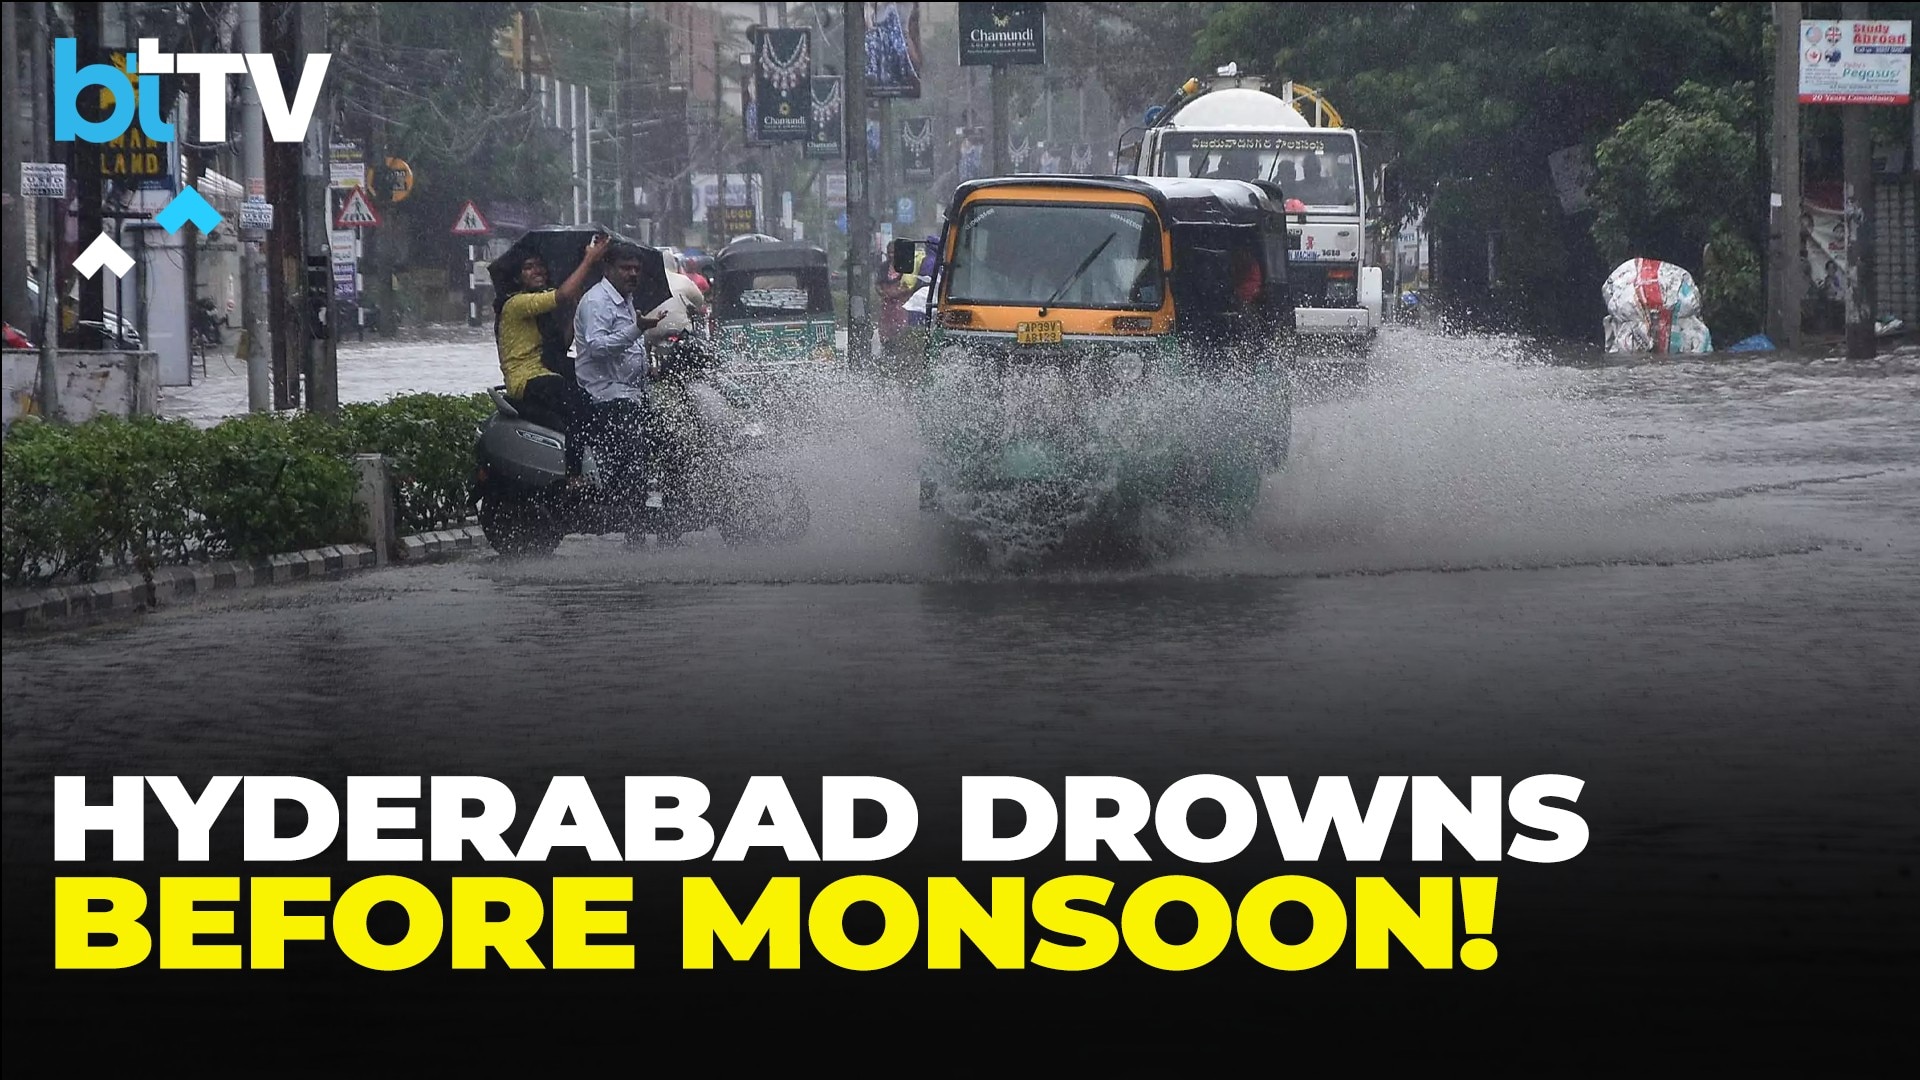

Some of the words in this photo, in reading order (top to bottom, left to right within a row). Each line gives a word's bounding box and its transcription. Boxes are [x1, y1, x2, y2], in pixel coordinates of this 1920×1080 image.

[1853, 23, 1889, 34] Study
[970, 28, 1033, 41] Chamundi
[1852, 33, 1906, 45] Abroad
[764, 116, 805, 125] Chamundi
[100, 153, 159, 175] LAND
[1026, 322, 1056, 332] AP39V
